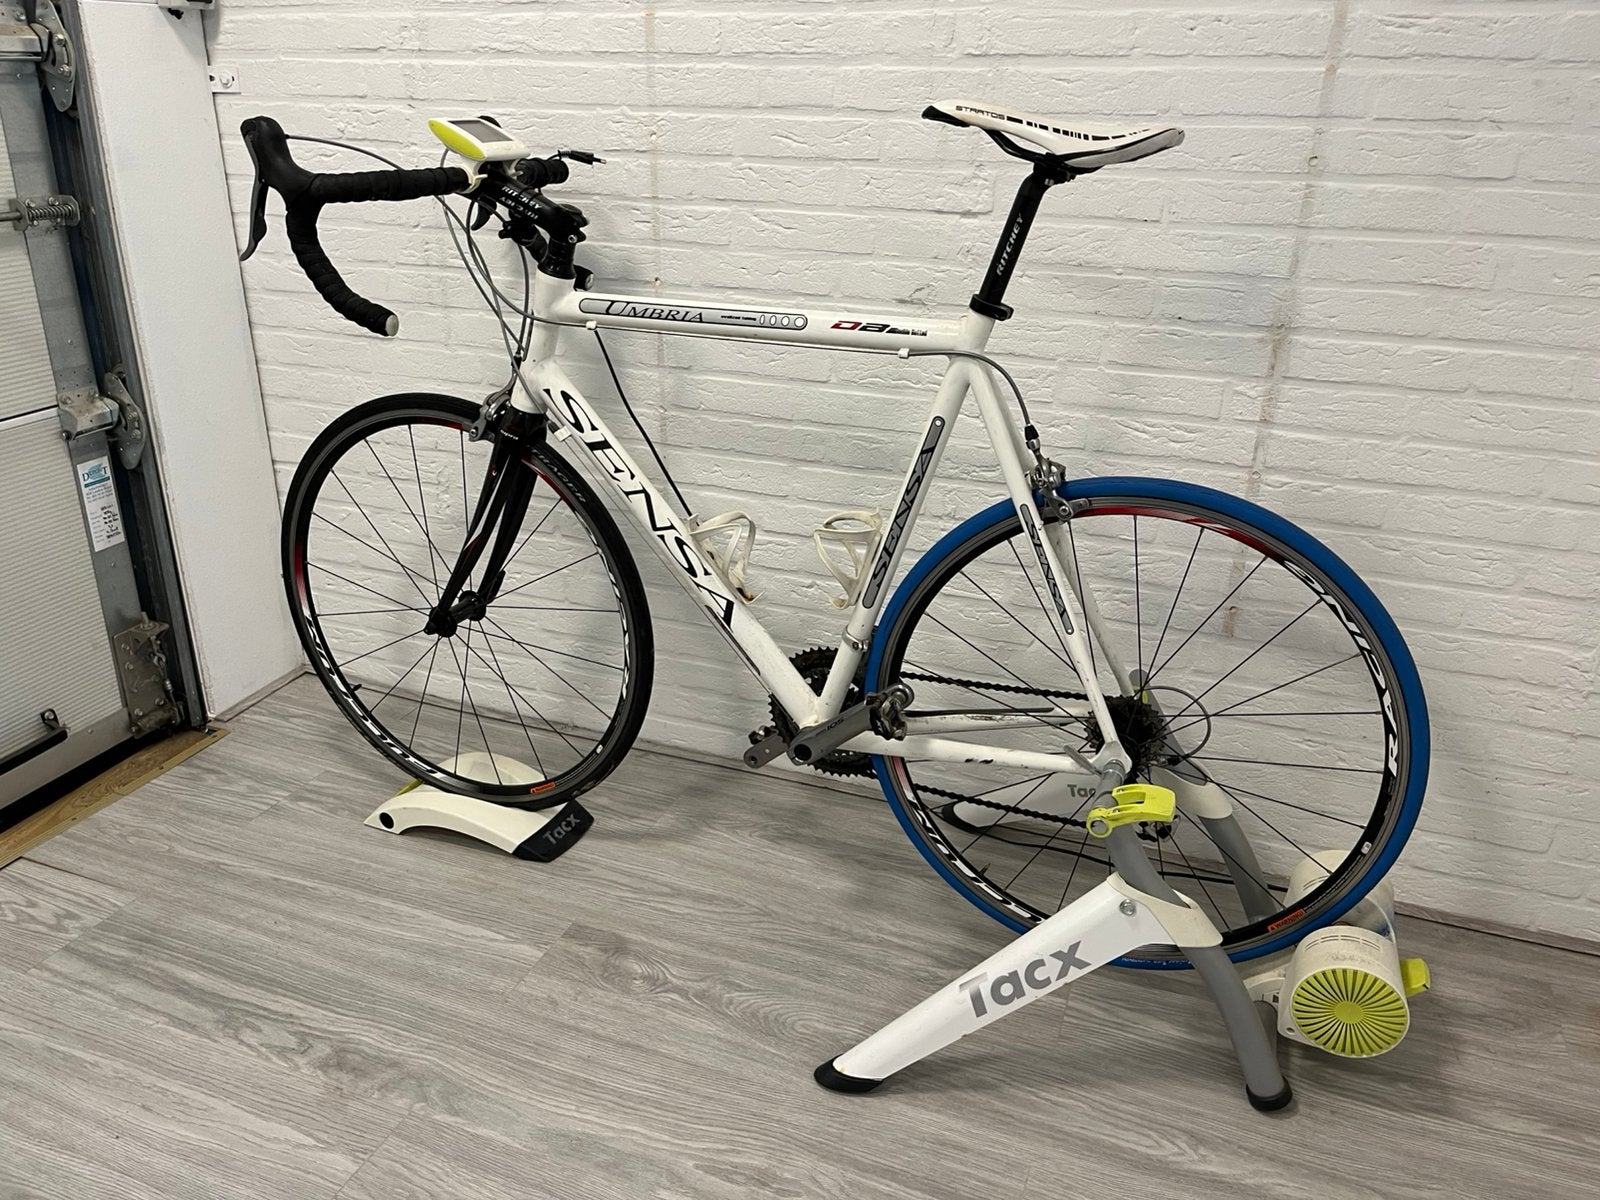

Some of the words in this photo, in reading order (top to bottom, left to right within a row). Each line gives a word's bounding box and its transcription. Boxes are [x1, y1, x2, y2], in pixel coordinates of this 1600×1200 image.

[955, 105, 1005, 120] STRATOS
[996, 212, 1023, 276] RITCHEY
[604, 300, 704, 323] UMBRIA
[542, 387, 735, 634] SENSA
[871, 445, 937, 592] SENSA
[1025, 520, 1067, 619] SENSA
[1283, 559, 1399, 778] RACING
[542, 813, 581, 846] Tacx
[1066, 783, 1097, 799] Tac
[907, 799, 1044, 923] LCRUM
[958, 939, 1093, 1019] Tacx
